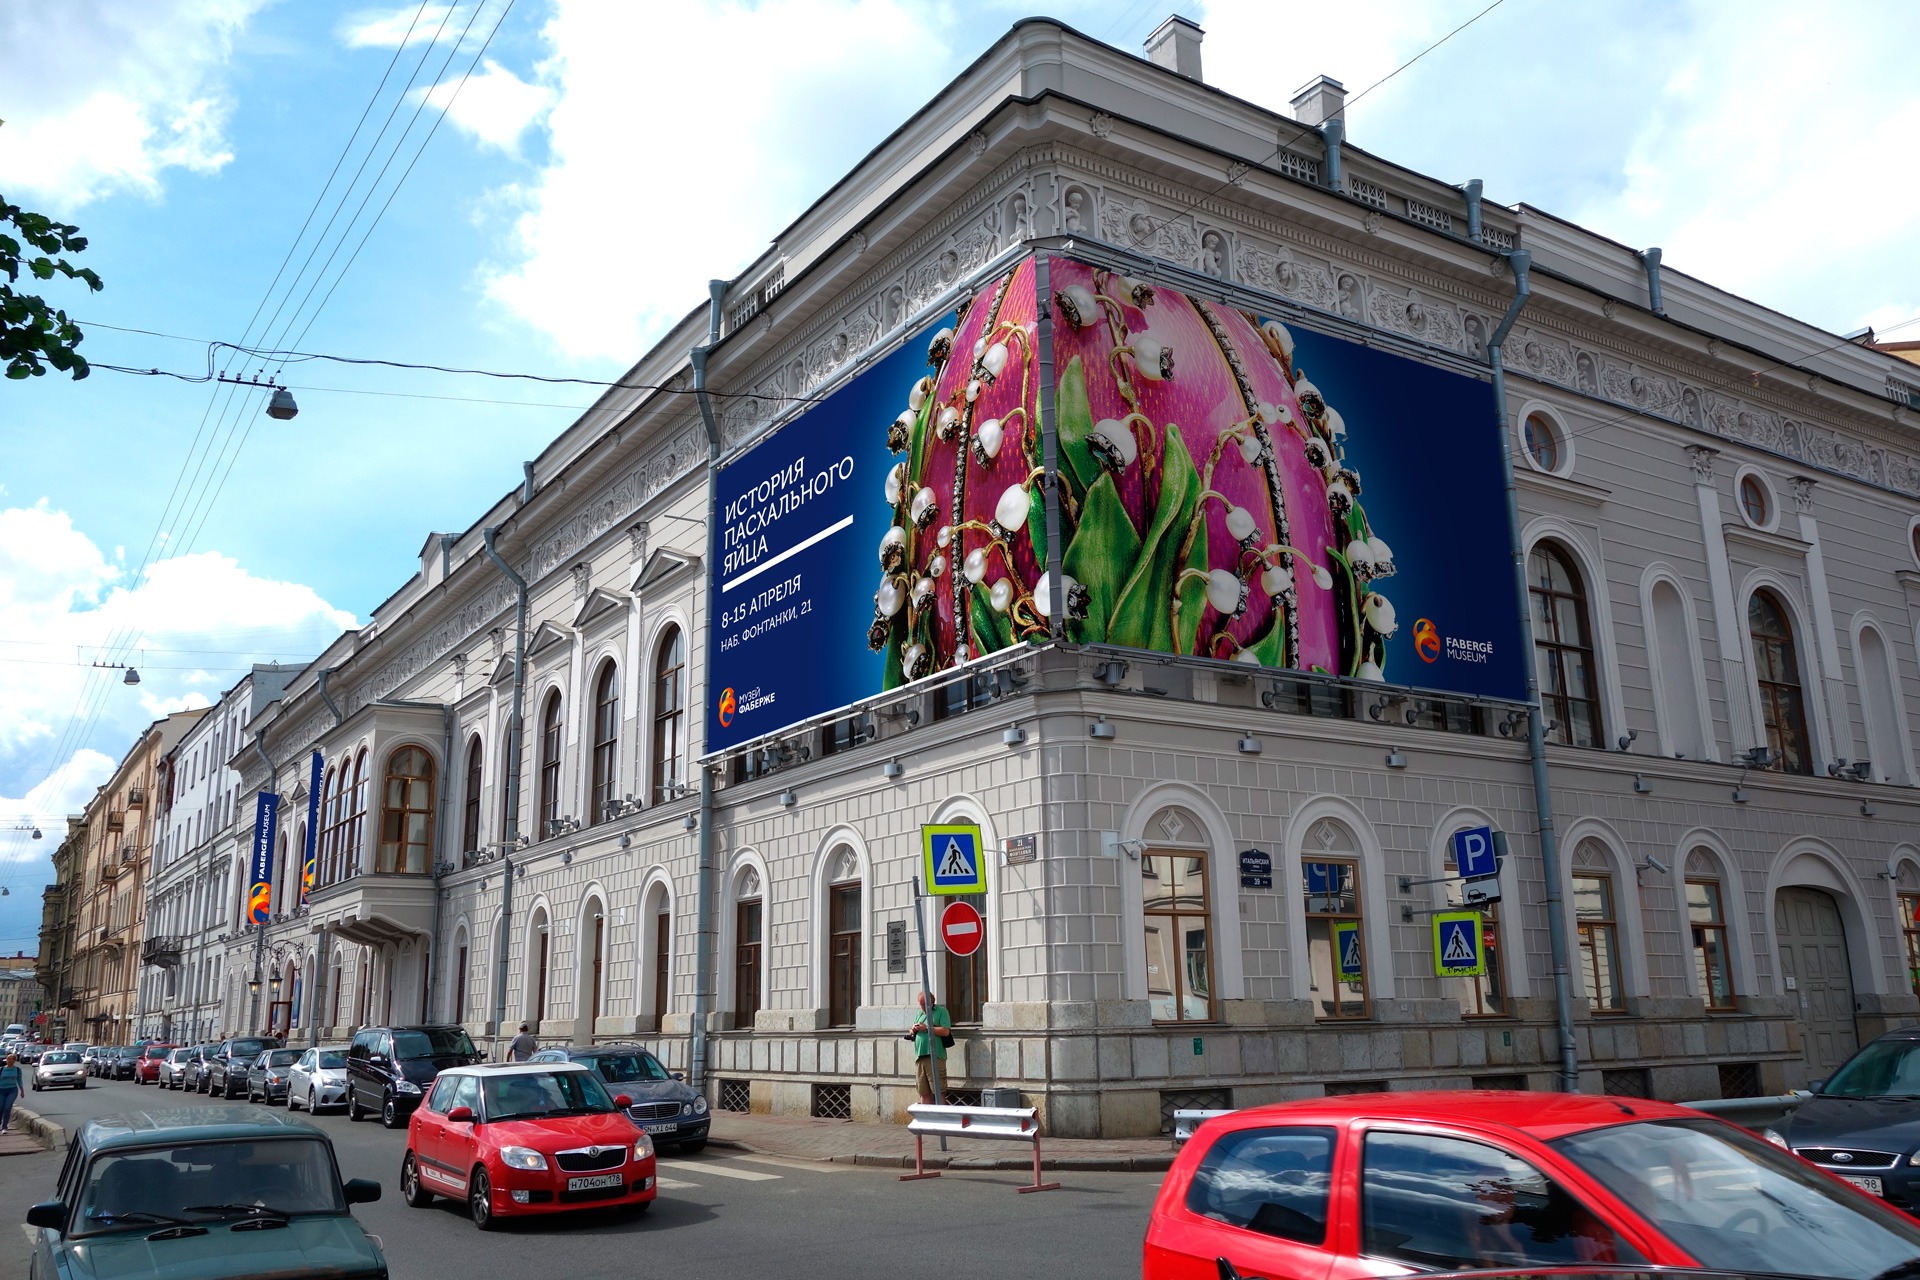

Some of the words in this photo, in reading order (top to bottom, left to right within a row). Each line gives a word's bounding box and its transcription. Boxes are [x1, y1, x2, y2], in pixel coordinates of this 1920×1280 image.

[724, 456, 854, 550] ПАСХАЛЬНОГО
[725, 456, 805, 524] ИСТОРИЯ
[723, 534, 768, 576] ЯЙЦА
[721, 602, 746, 629] 8-15
[749, 574, 802, 615] АПРЕЛЯ
[721, 634, 740, 652] НАБ.
[742, 606, 799, 641] ФОНТАНКИ,
[800, 599, 813, 615] 21
[1447, 648, 1487, 664] MUSEUM
[738, 686, 761, 705] МУЗЕЙ
[738, 692, 776, 714] ФАБЕРЖЕ
[262, 804, 270, 838] MUSEUM
[1465, 834, 1486, 871] P
[608, 1174, 621, 1183] 178
[1864, 1179, 1877, 1189] 98
